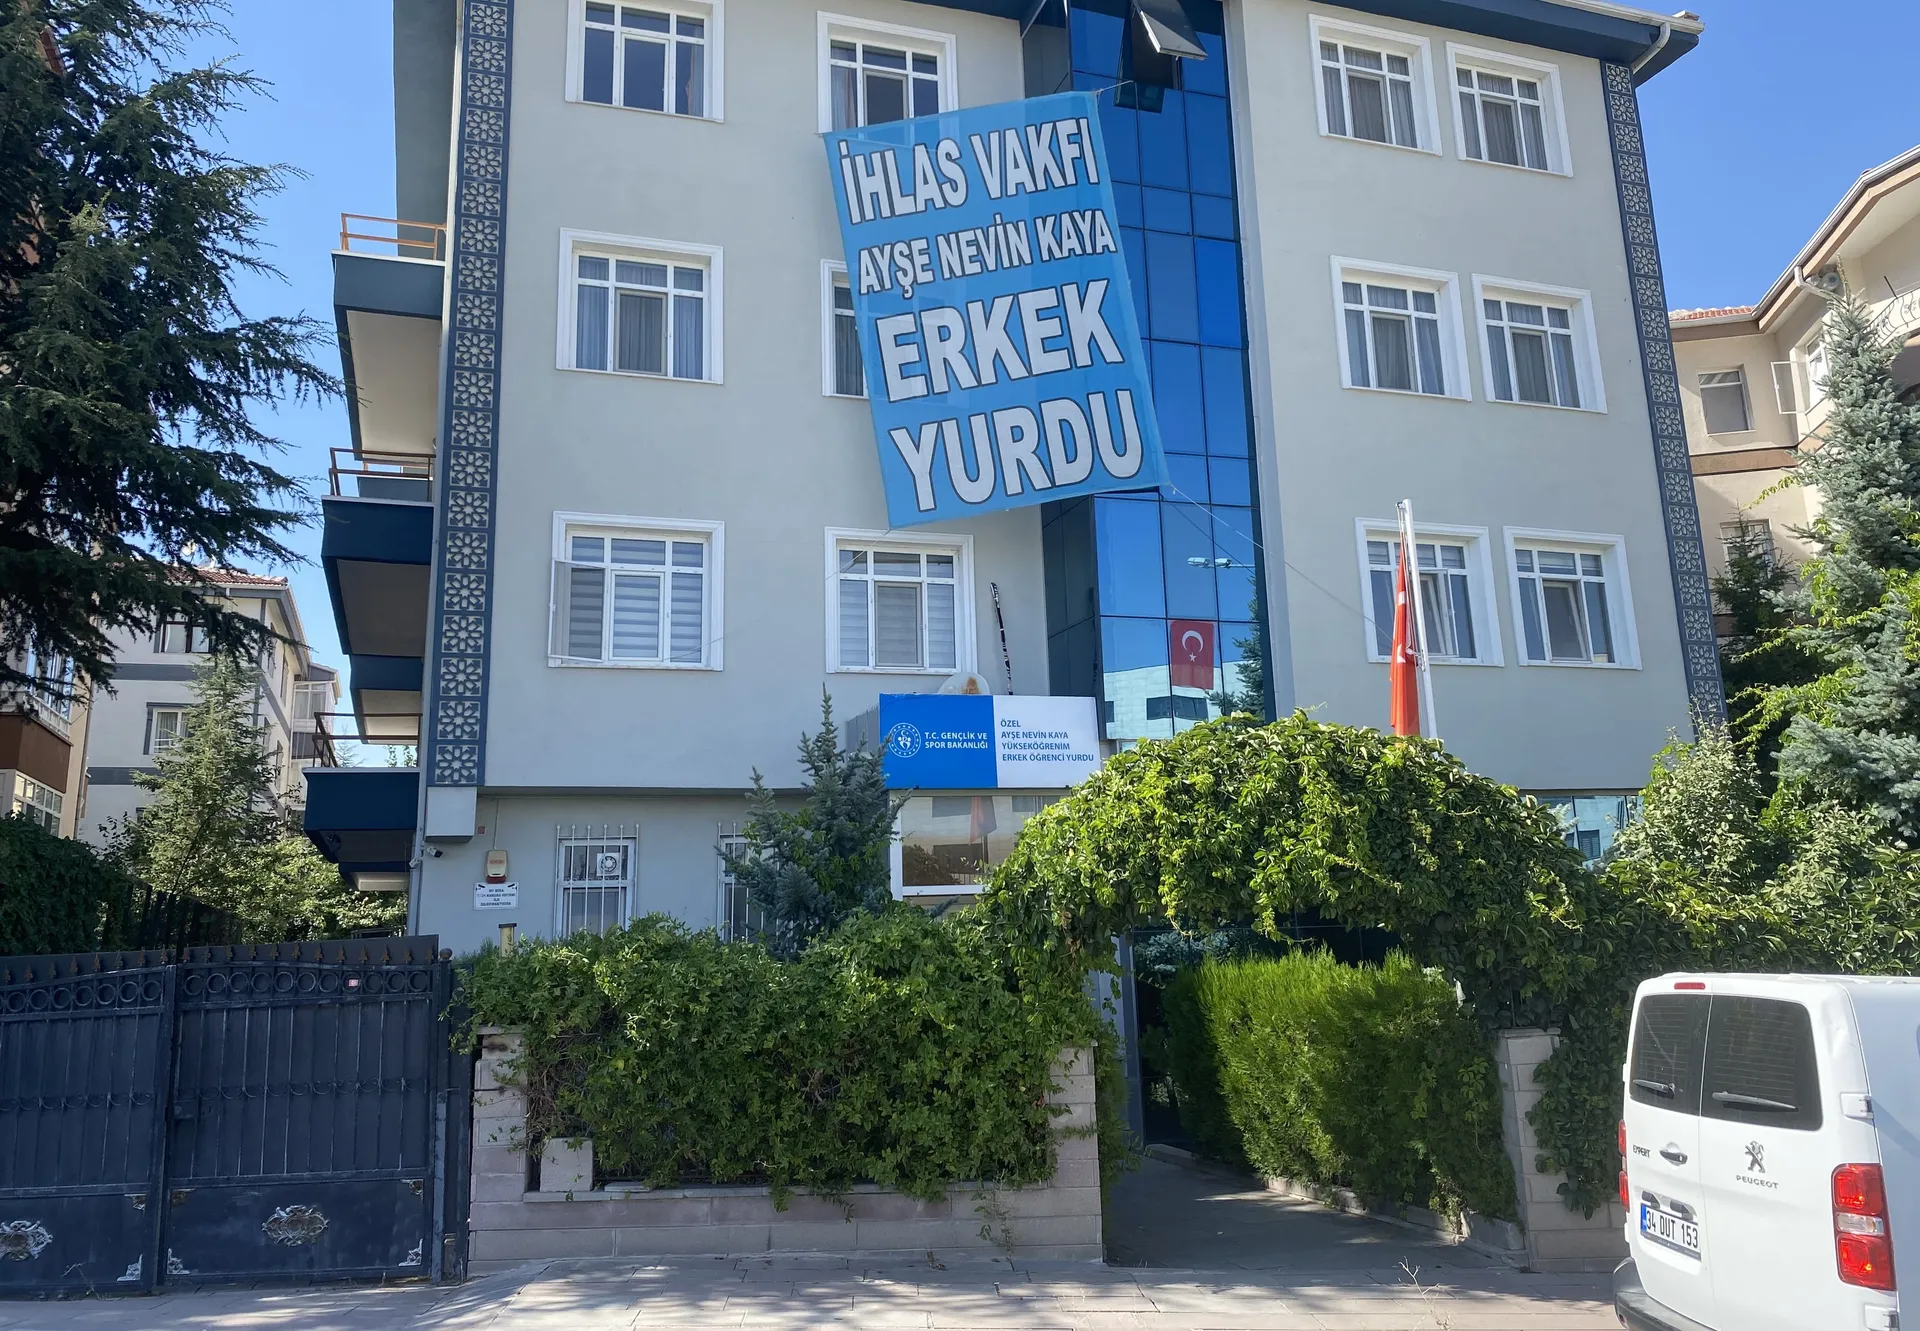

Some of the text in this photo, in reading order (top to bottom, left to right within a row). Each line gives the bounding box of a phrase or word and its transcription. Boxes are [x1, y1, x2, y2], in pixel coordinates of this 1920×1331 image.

[838, 118, 1099, 225] İHLAS VAKFI
[858, 208, 1117, 298] AYŞE NEVİN KAYA
[875, 278, 1125, 403] ERKEK
[888, 389, 1144, 513] YURDU
[1000, 719, 1021, 728] ÖZEL
[924, 731, 988, 741] T.C. GENÇLİK VE
[1001, 730, 1069, 740] AYŞE NEVİN KAYA
[925, 740, 988, 749] SPOR BAKANLIĞI
[1002, 741, 1071, 750] YÜKSEKÖĞRENİM
[1002, 752, 1094, 762] ERKEK ÖĞRENCİ YURDU
[1736, 1174, 1779, 1190] PEUGEOT
[1646, 1210, 1656, 1232] 34
[1660, 1214, 1676, 1240] DUT
[1681, 1223, 1699, 1249] 153
